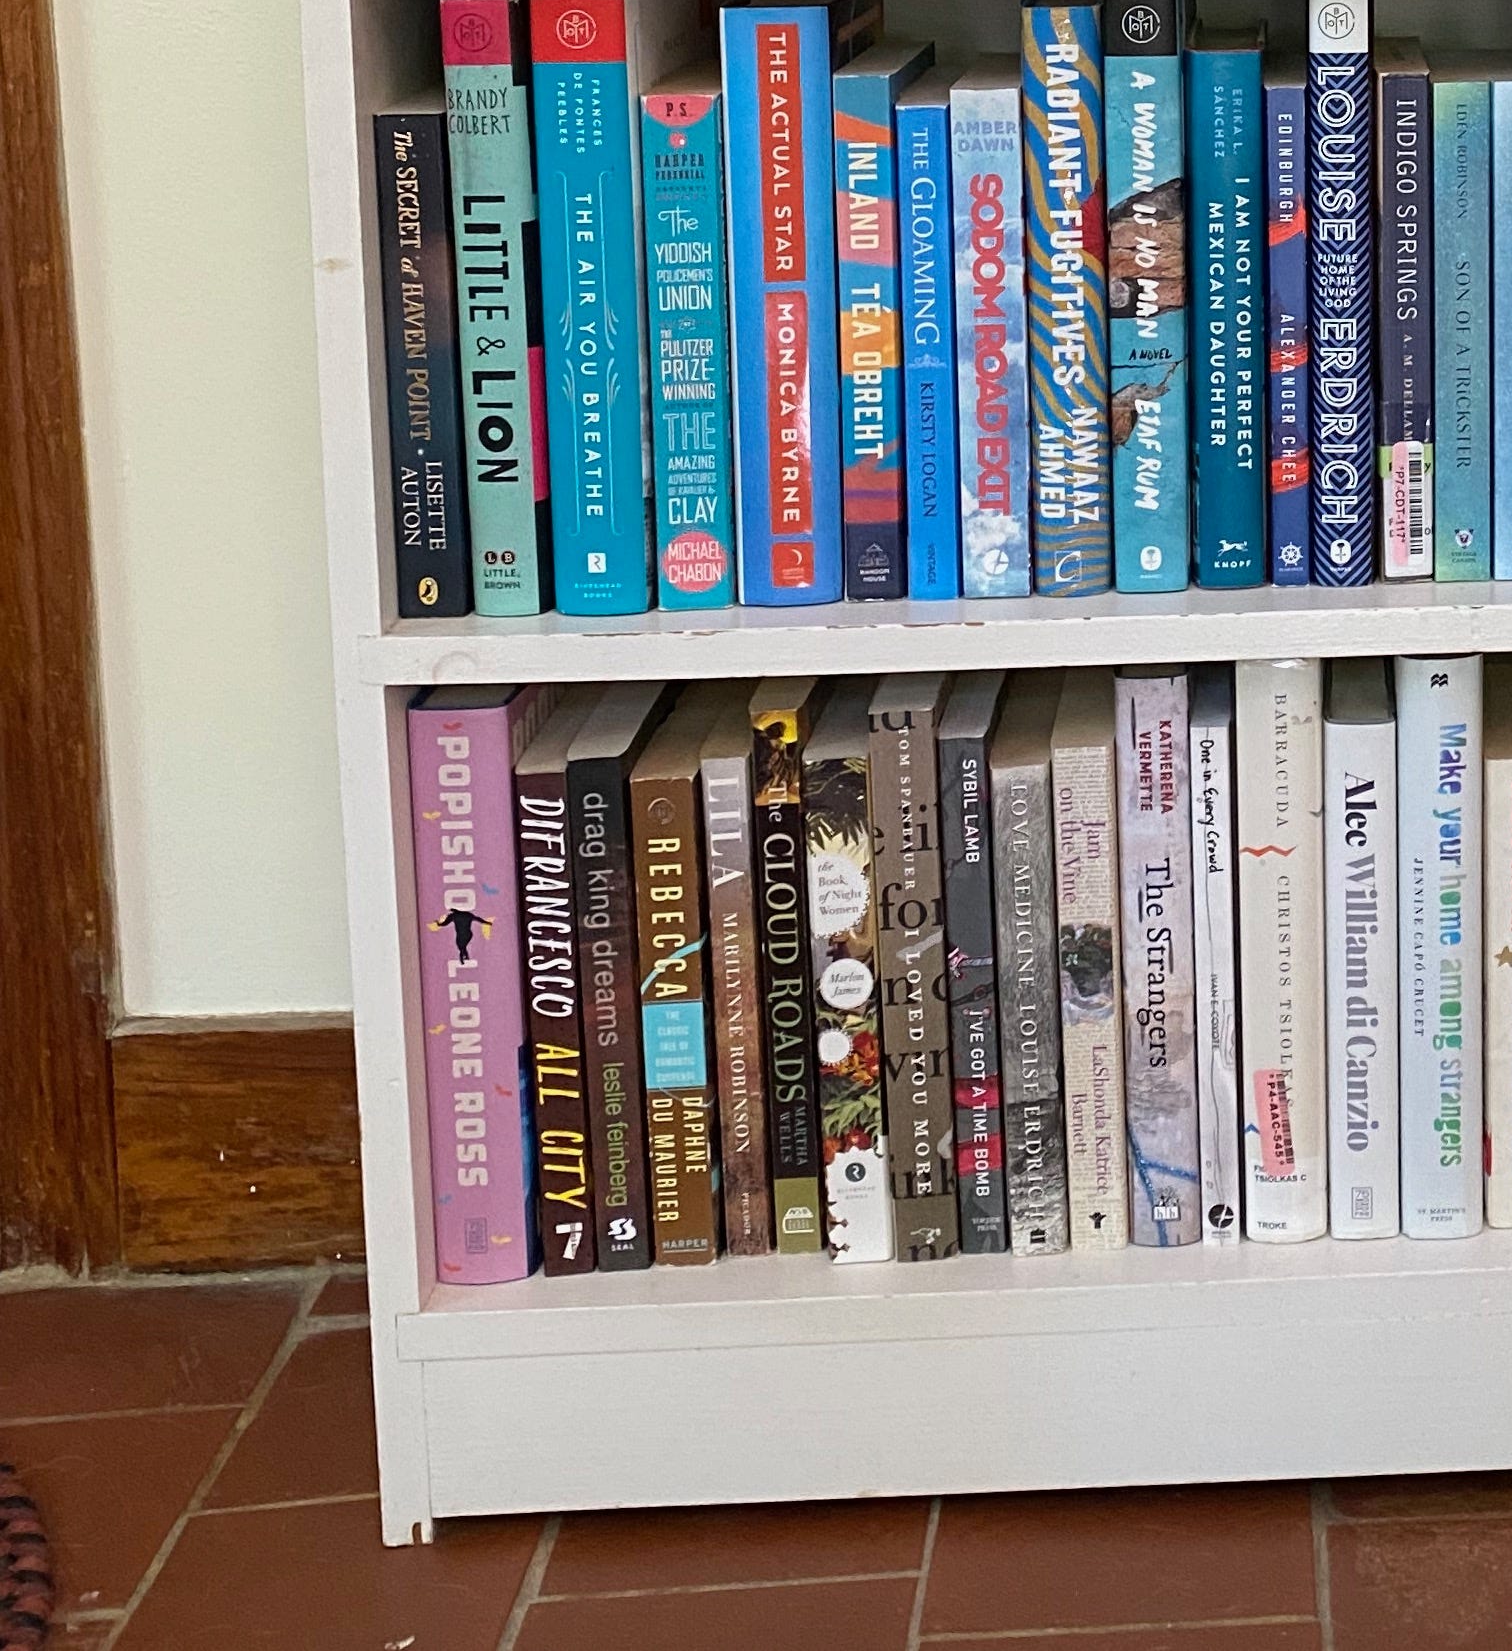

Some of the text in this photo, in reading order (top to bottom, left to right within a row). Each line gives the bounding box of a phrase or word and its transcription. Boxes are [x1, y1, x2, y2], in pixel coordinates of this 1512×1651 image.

[449, 88, 507, 111] BRANDY
[449, 114, 510, 135] COLBERT
[953, 121, 1017, 135] AMBER
[769, 32, 792, 272] THE ACTUAL STAR
[959, 139, 1014, 153] DAWN
[1317, 66, 1356, 241] LOUISE
[848, 142, 879, 250] INLAND
[1235, 195, 1250, 228] AM
[658, 207, 698, 237] The
[655, 243, 712, 263] YIDDISH
[1235, 238, 1250, 286] NOT
[1318, 254, 1358, 263] FUTURE
[657, 270, 713, 283] POLICEMEN'S
[1321, 266, 1354, 274] HOME
[659, 286, 712, 311] UNION
[1325, 299, 1351, 307] GOD
[463, 195, 519, 483] LITTLE & LION
[1208, 203, 1226, 447] MEXICAN DAUGHTER
[1237, 298, 1251, 359] YOUR
[661, 340, 713, 357] PULITZER
[778, 304, 801, 523] MONICA BYRNE
[1237, 372, 1252, 469] PERFECT
[1321, 318, 1359, 524] ERDRICH
[668, 456, 716, 470] AMAZING
[920, 382, 937, 518] KIRSTY LOGAN
[668, 544, 722, 560] MICHAEL
[1214, 560, 1251, 568] KNOPF
[669, 563, 722, 582] CHABON
[1139, 732, 1153, 811] VERMETTE
[1159, 720, 1173, 814] KATHERENA
[963, 759, 979, 863] SYBIL LAMB
[1345, 771, 1378, 848] Alec
[818, 876, 846, 887] Book
[580, 792, 619, 1046] drag king dreams
[648, 837, 687, 998] REBECCA
[819, 905, 859, 916] Women
[1345, 854, 1378, 988] William
[831, 973, 866, 984] Marlon
[1136, 858, 1173, 1068] The Strangers
[832, 985, 862, 997] James
[1346, 996, 1378, 1029] di
[1345, 1035, 1379, 1152] Canzio
[601, 1062, 629, 1206] leslie feinberg
[682, 1097, 706, 1173] DAPHNE
[650, 1099, 678, 1222] DU MAURIER
[1257, 1221, 1287, 1230] TROKE
[663, 1239, 708, 1248] HARPER
